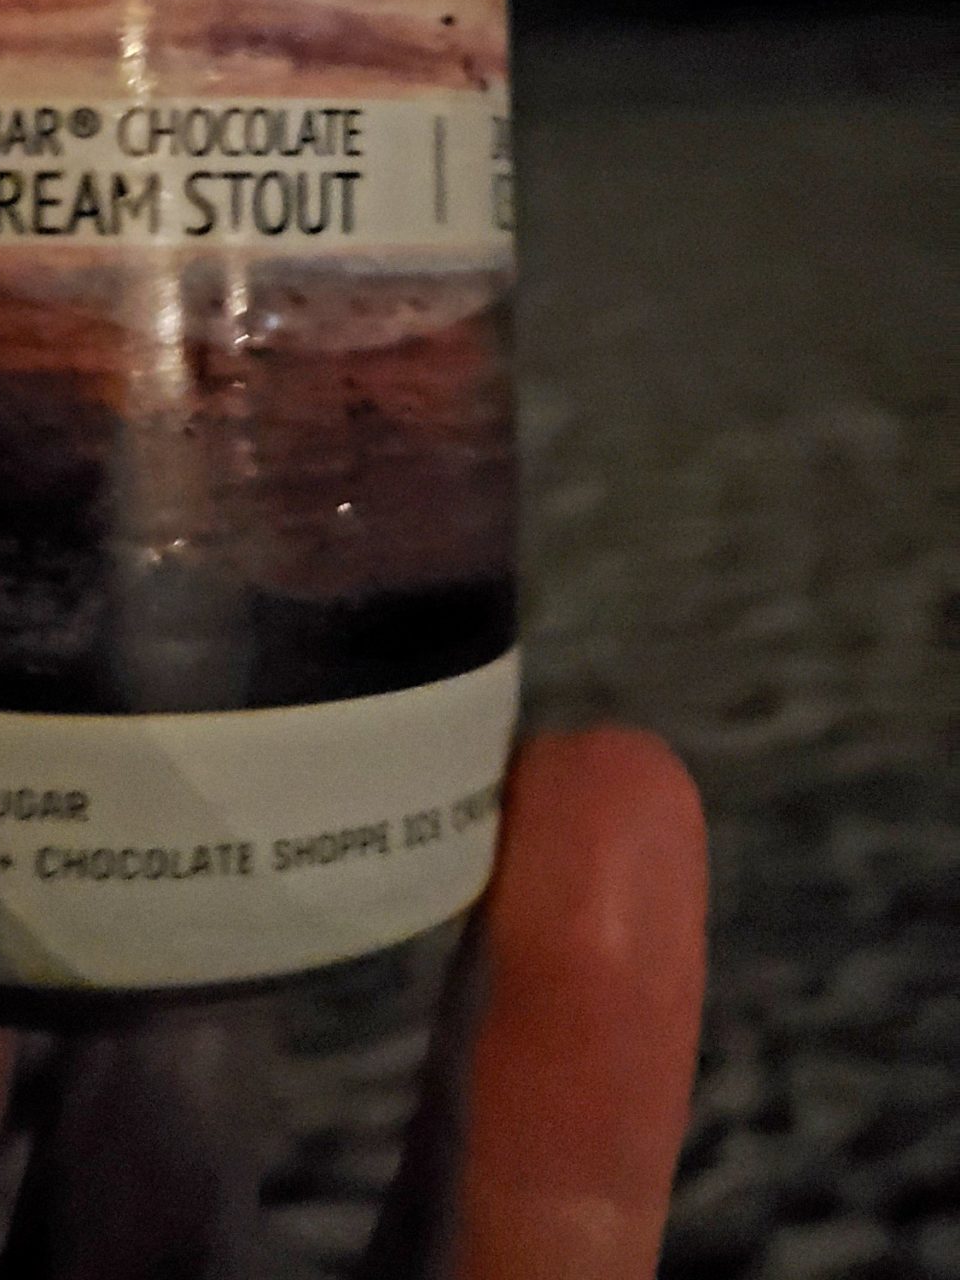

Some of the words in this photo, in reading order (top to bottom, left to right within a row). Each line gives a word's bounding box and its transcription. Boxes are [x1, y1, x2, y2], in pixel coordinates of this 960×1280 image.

[117, 106, 362, 157] CHOCOLATE
[184, 169, 363, 236] STOUT
[34, 841, 256, 881] CHOCOLATE
[272, 820, 391, 872] SHOPPE
